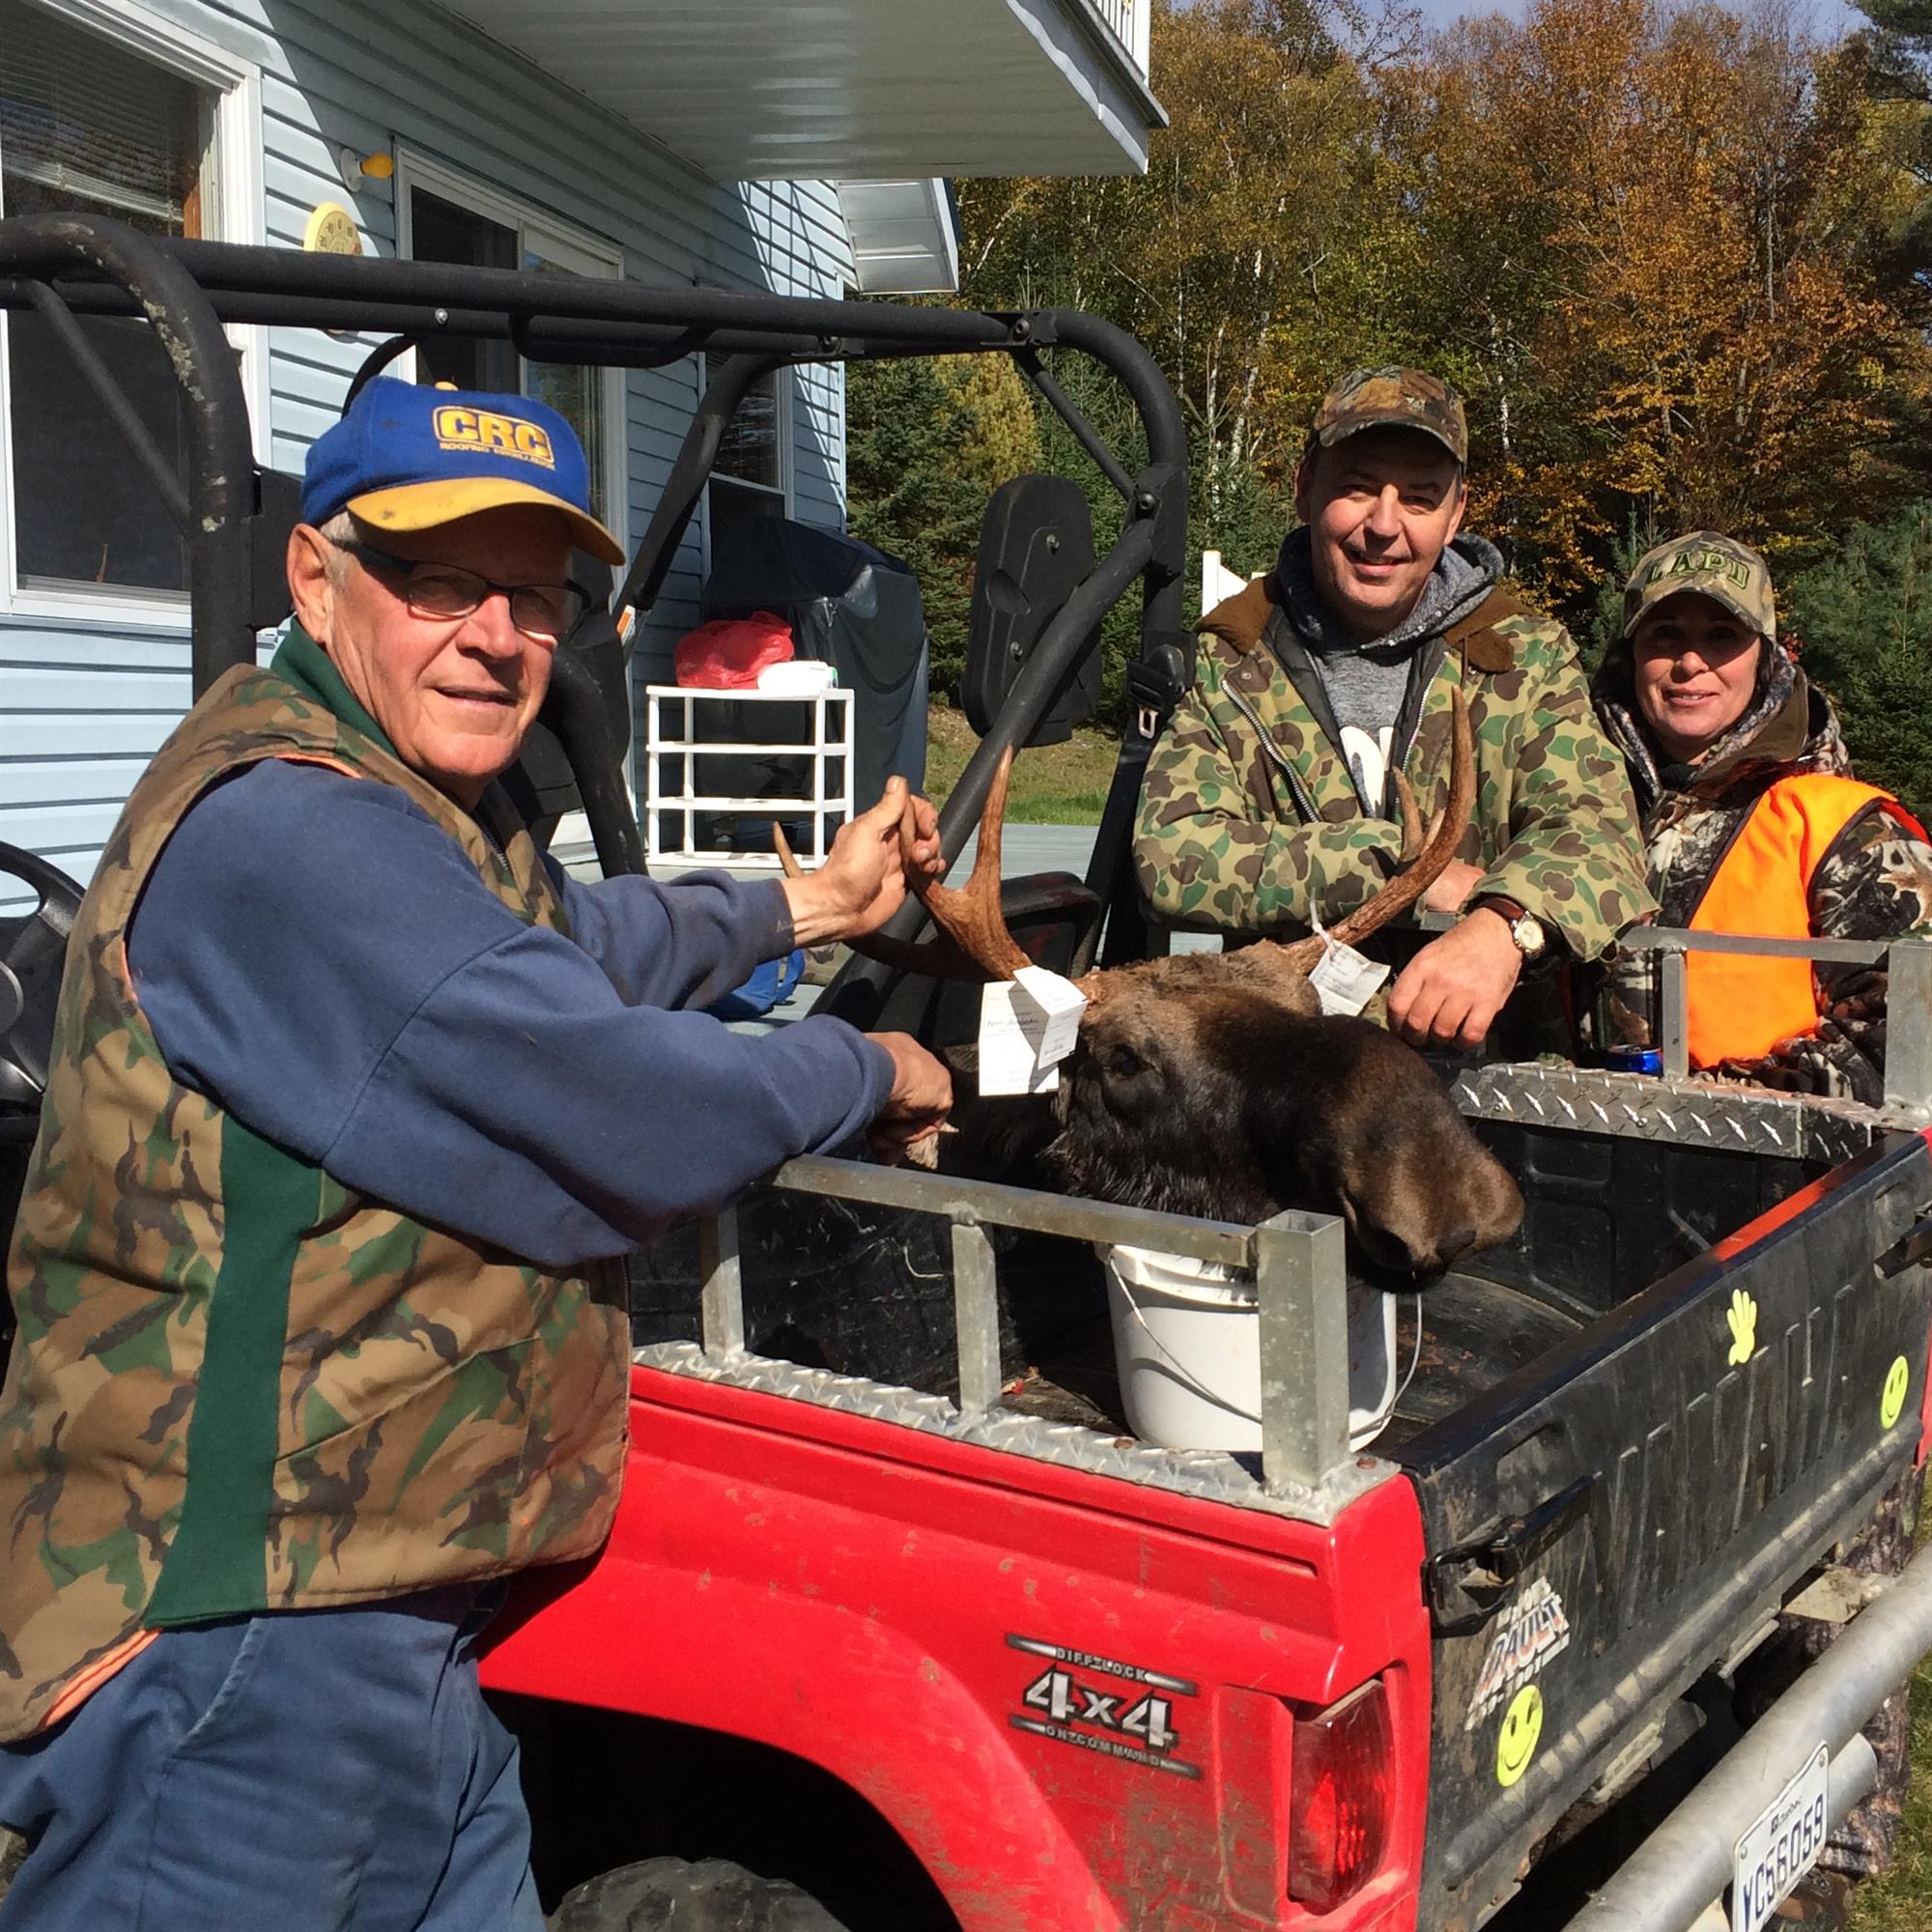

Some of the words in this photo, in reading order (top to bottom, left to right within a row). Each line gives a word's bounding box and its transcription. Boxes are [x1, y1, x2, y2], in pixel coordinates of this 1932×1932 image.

[440, 409, 549, 459] CRC
[1646, 549, 1749, 589] LAPD
[1023, 1665, 1178, 1752] 4x4
[1743, 1793, 1824, 1932] YC56059
